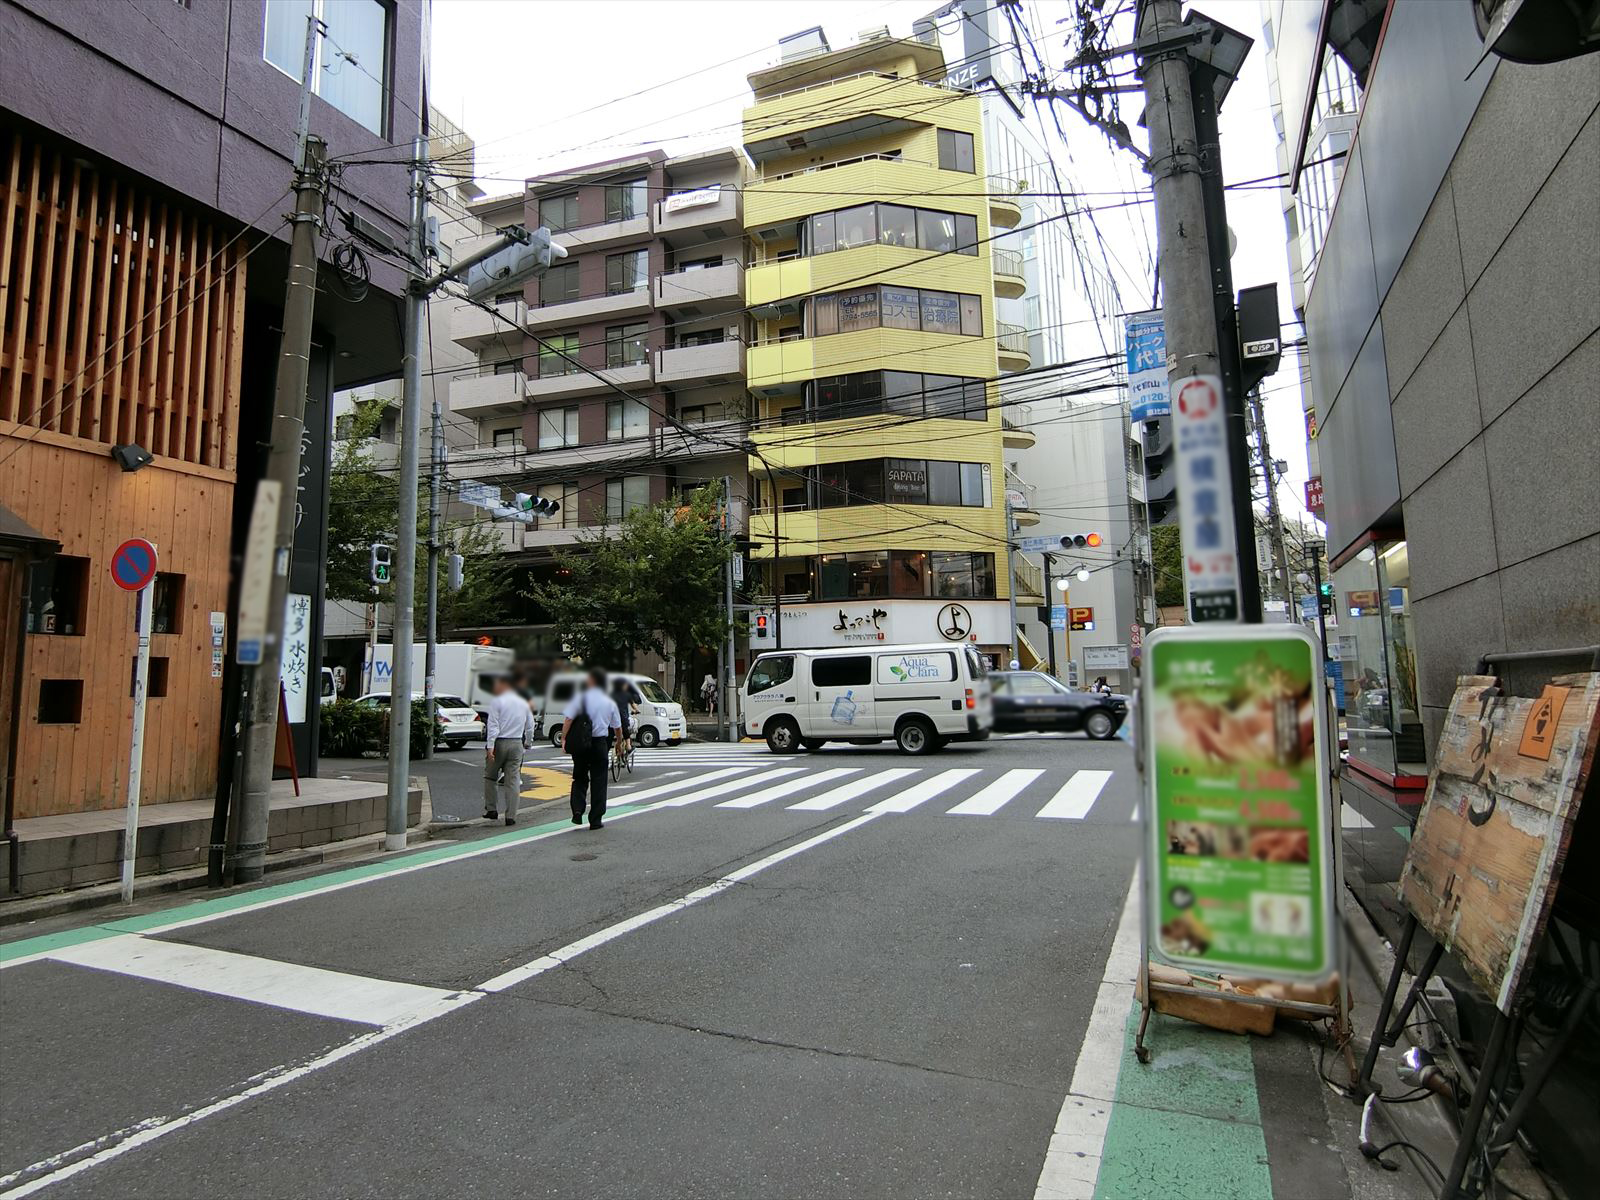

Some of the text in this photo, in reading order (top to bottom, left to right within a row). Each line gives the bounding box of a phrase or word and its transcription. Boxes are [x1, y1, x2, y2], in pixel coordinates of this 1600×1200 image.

[944, 64, 979, 88] NZE
[888, 470, 924, 481] SAPATA
[900, 656, 929, 670] Aqua
[907, 665, 939, 678] Clara
